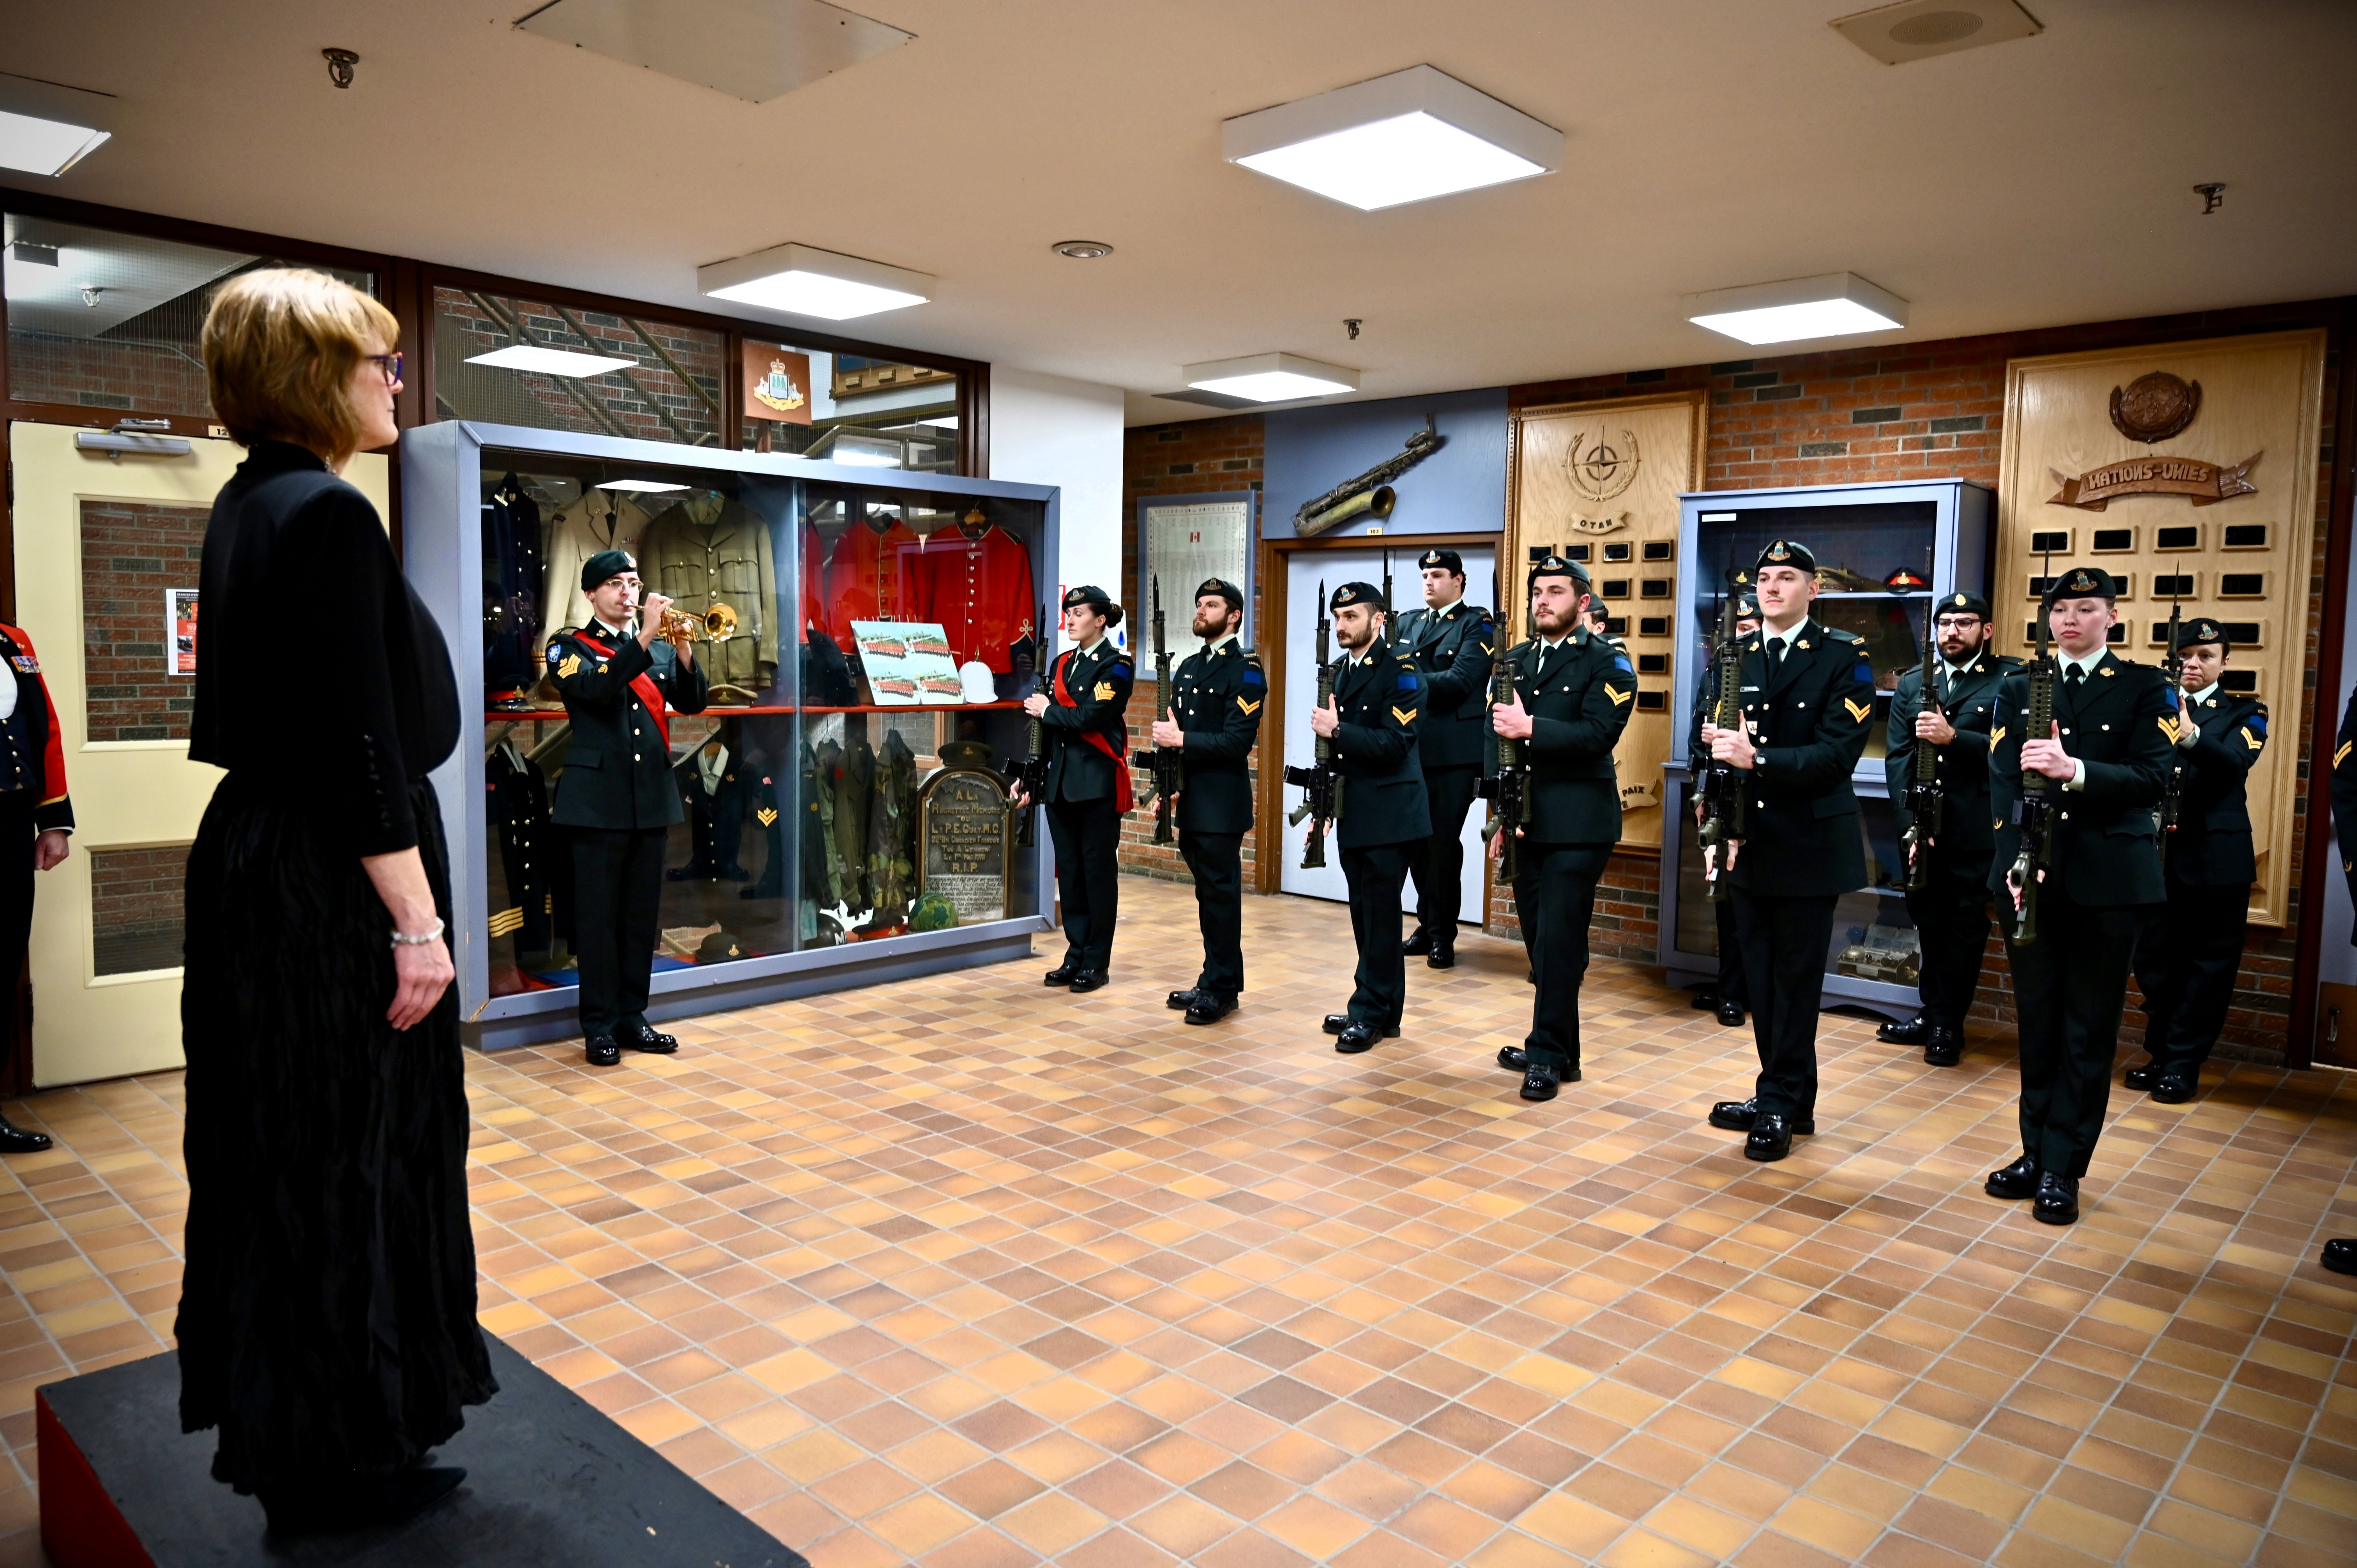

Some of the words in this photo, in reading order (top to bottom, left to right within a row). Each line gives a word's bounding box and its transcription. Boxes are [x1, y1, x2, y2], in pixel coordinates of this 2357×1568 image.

[2088, 464, 2210, 490] NATIONS-UNIES
[1580, 519, 1612, 529] OTAN
[956, 790, 963, 800] A
[1622, 786, 1644, 797] PAIX
[952, 863, 977, 873] R.I.P.
[834, 931, 847, 946] M
